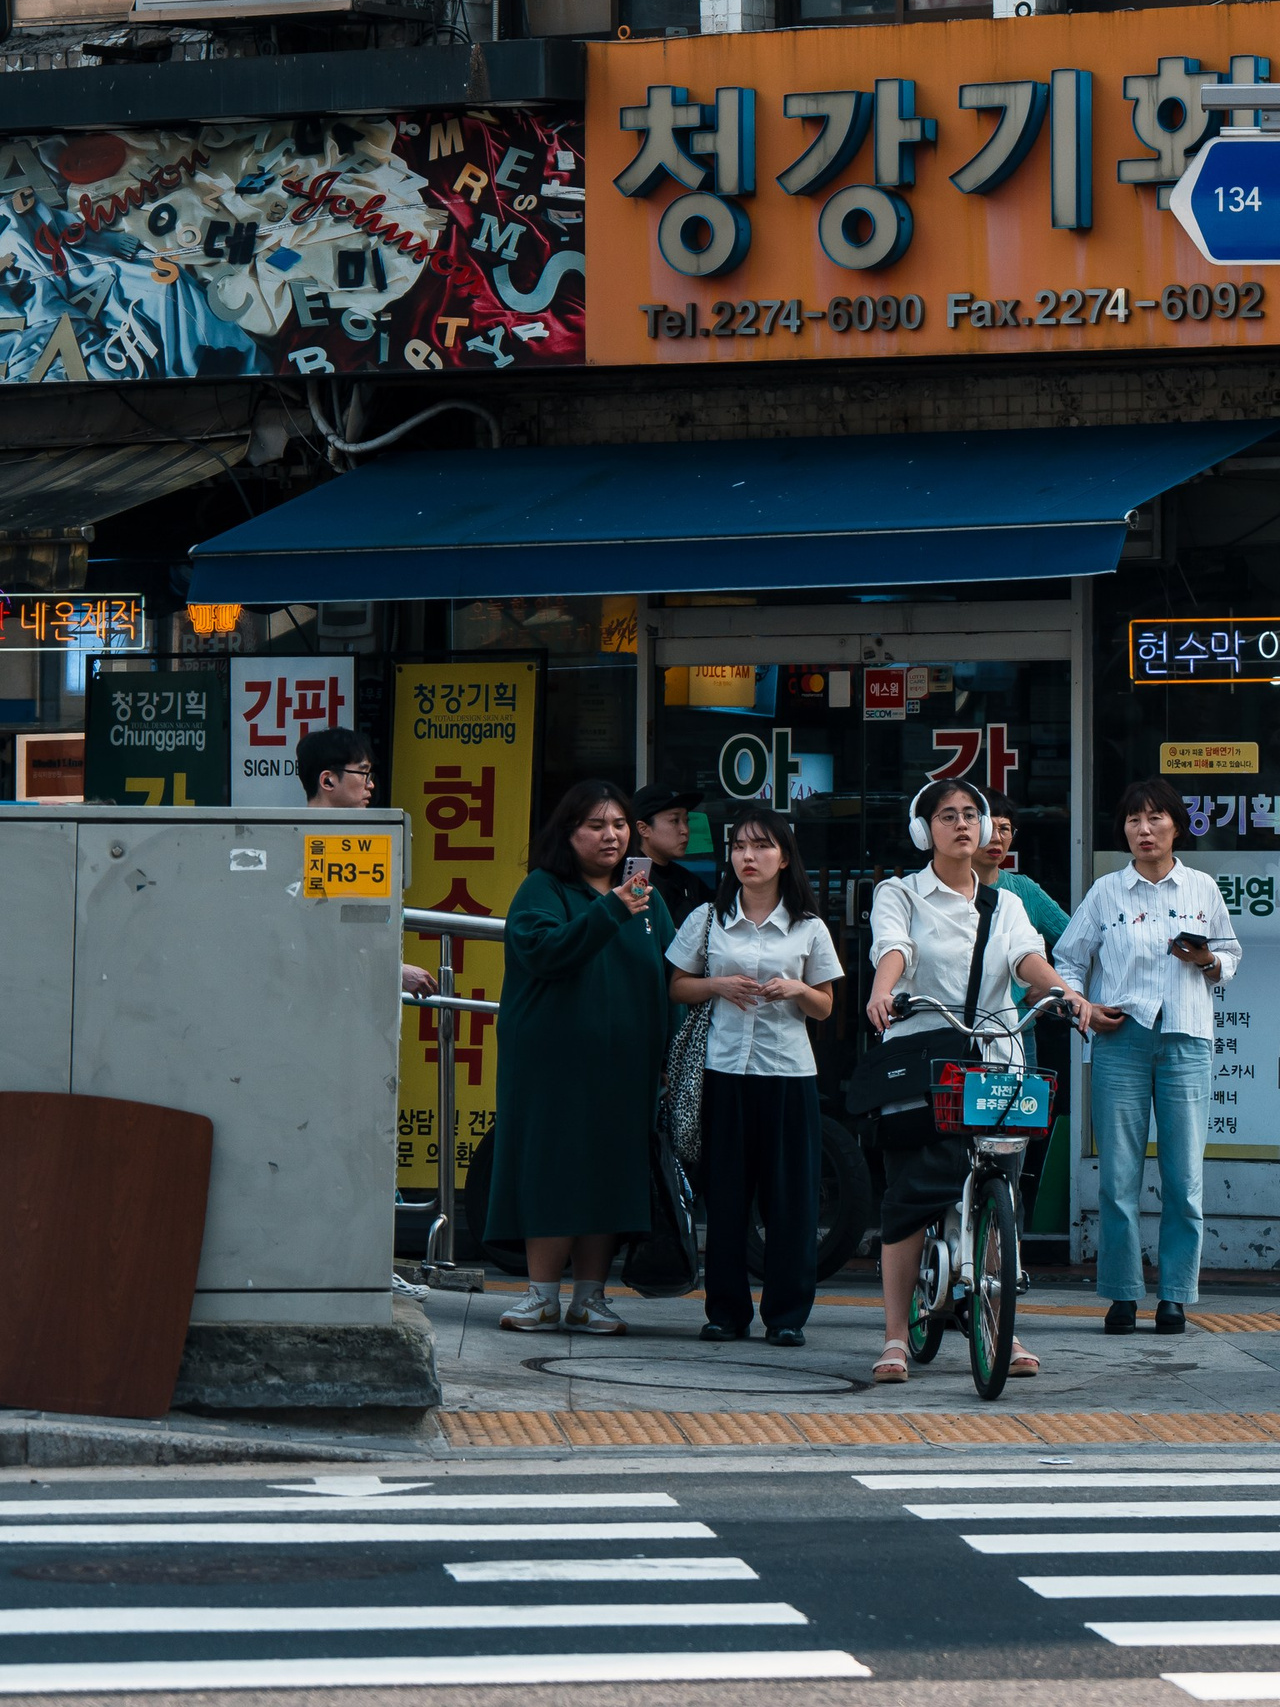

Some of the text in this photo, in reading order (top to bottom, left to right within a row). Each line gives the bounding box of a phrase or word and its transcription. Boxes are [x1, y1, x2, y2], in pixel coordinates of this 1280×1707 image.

[1214, 186, 1262, 212] 134
[638, 281, 1266, 339] Tel.2274-6090 Fax.2274-6092
[21, 599, 142, 642] 네온제작
[1137, 629, 1246, 674] 현수막
[413, 682, 517, 714] 청강기획
[869, 682, 900, 697] 에스원
[111, 690, 207, 722] 청강기획
[865, 709, 892, 719] SECOM
[110, 724, 207, 752] Chunggang
[413, 718, 516, 744] Chunggang
[1178, 747, 1191, 757] 내가
[1193, 758, 1215, 769] 피해를
[1215, 759, 1228, 769] 주고
[243, 759, 280, 777] SIGN
[309, 840, 325, 892] 을지로
[327, 862, 385, 883] R3-5
